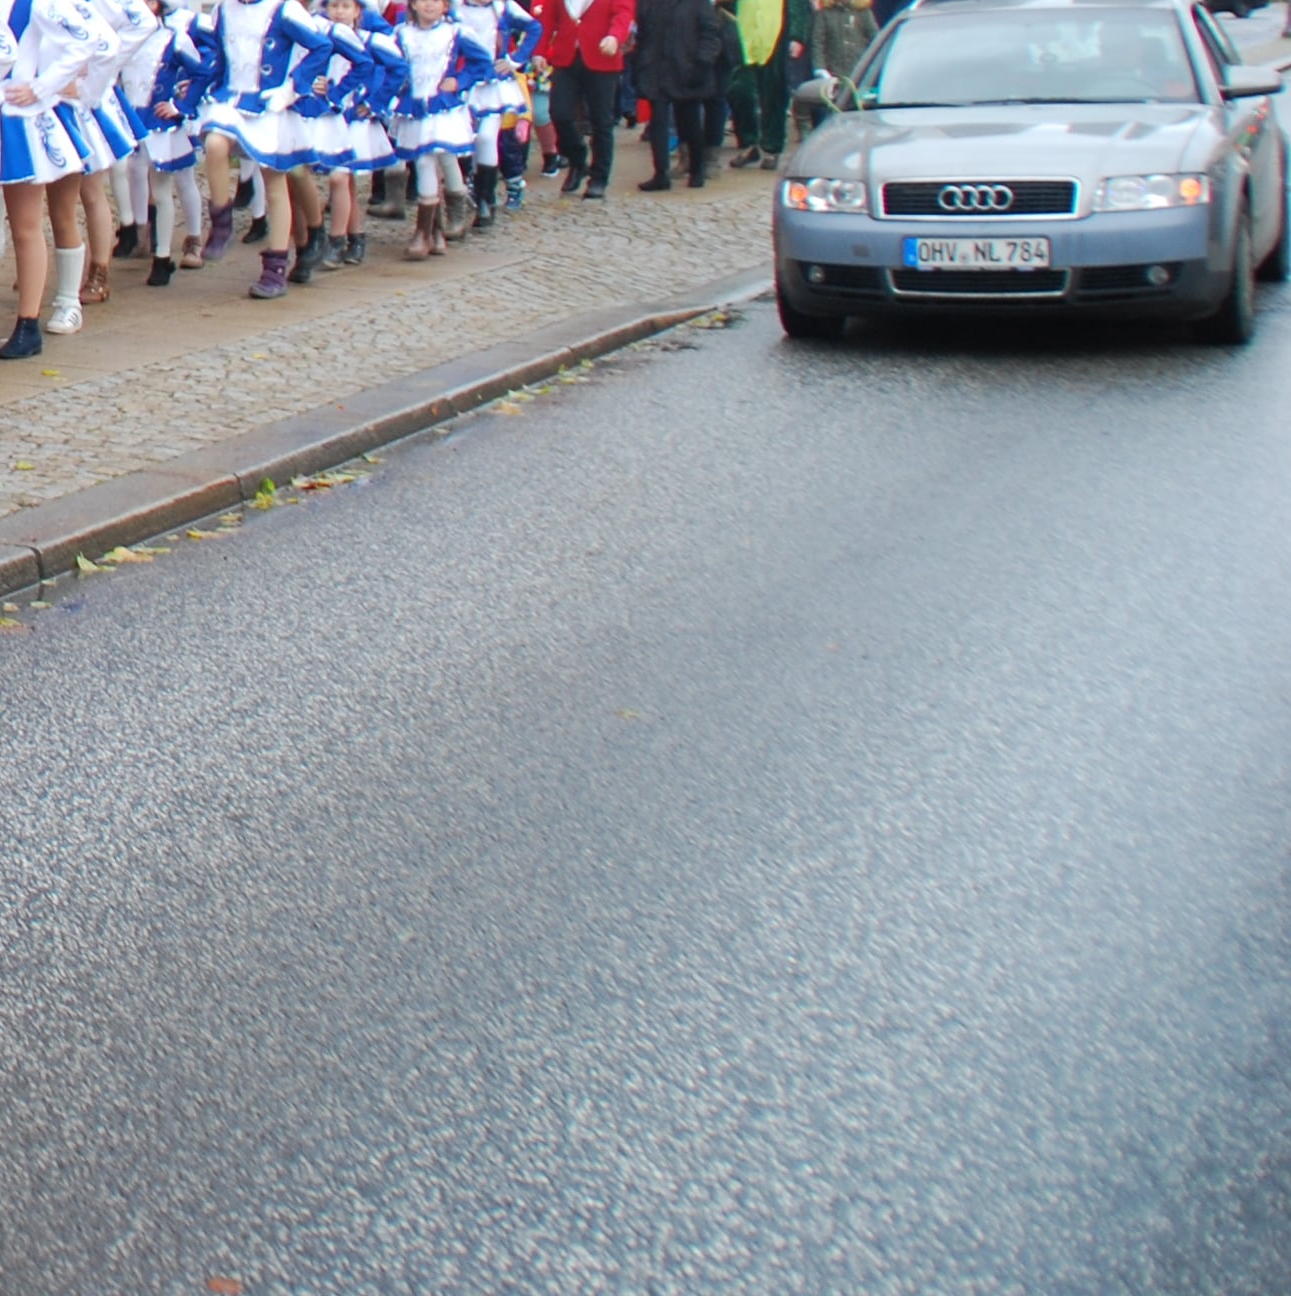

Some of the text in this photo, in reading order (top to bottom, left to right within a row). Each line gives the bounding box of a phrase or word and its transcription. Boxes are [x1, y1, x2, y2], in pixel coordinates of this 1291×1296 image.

[919, 241, 1045, 262] OHV NL 784
